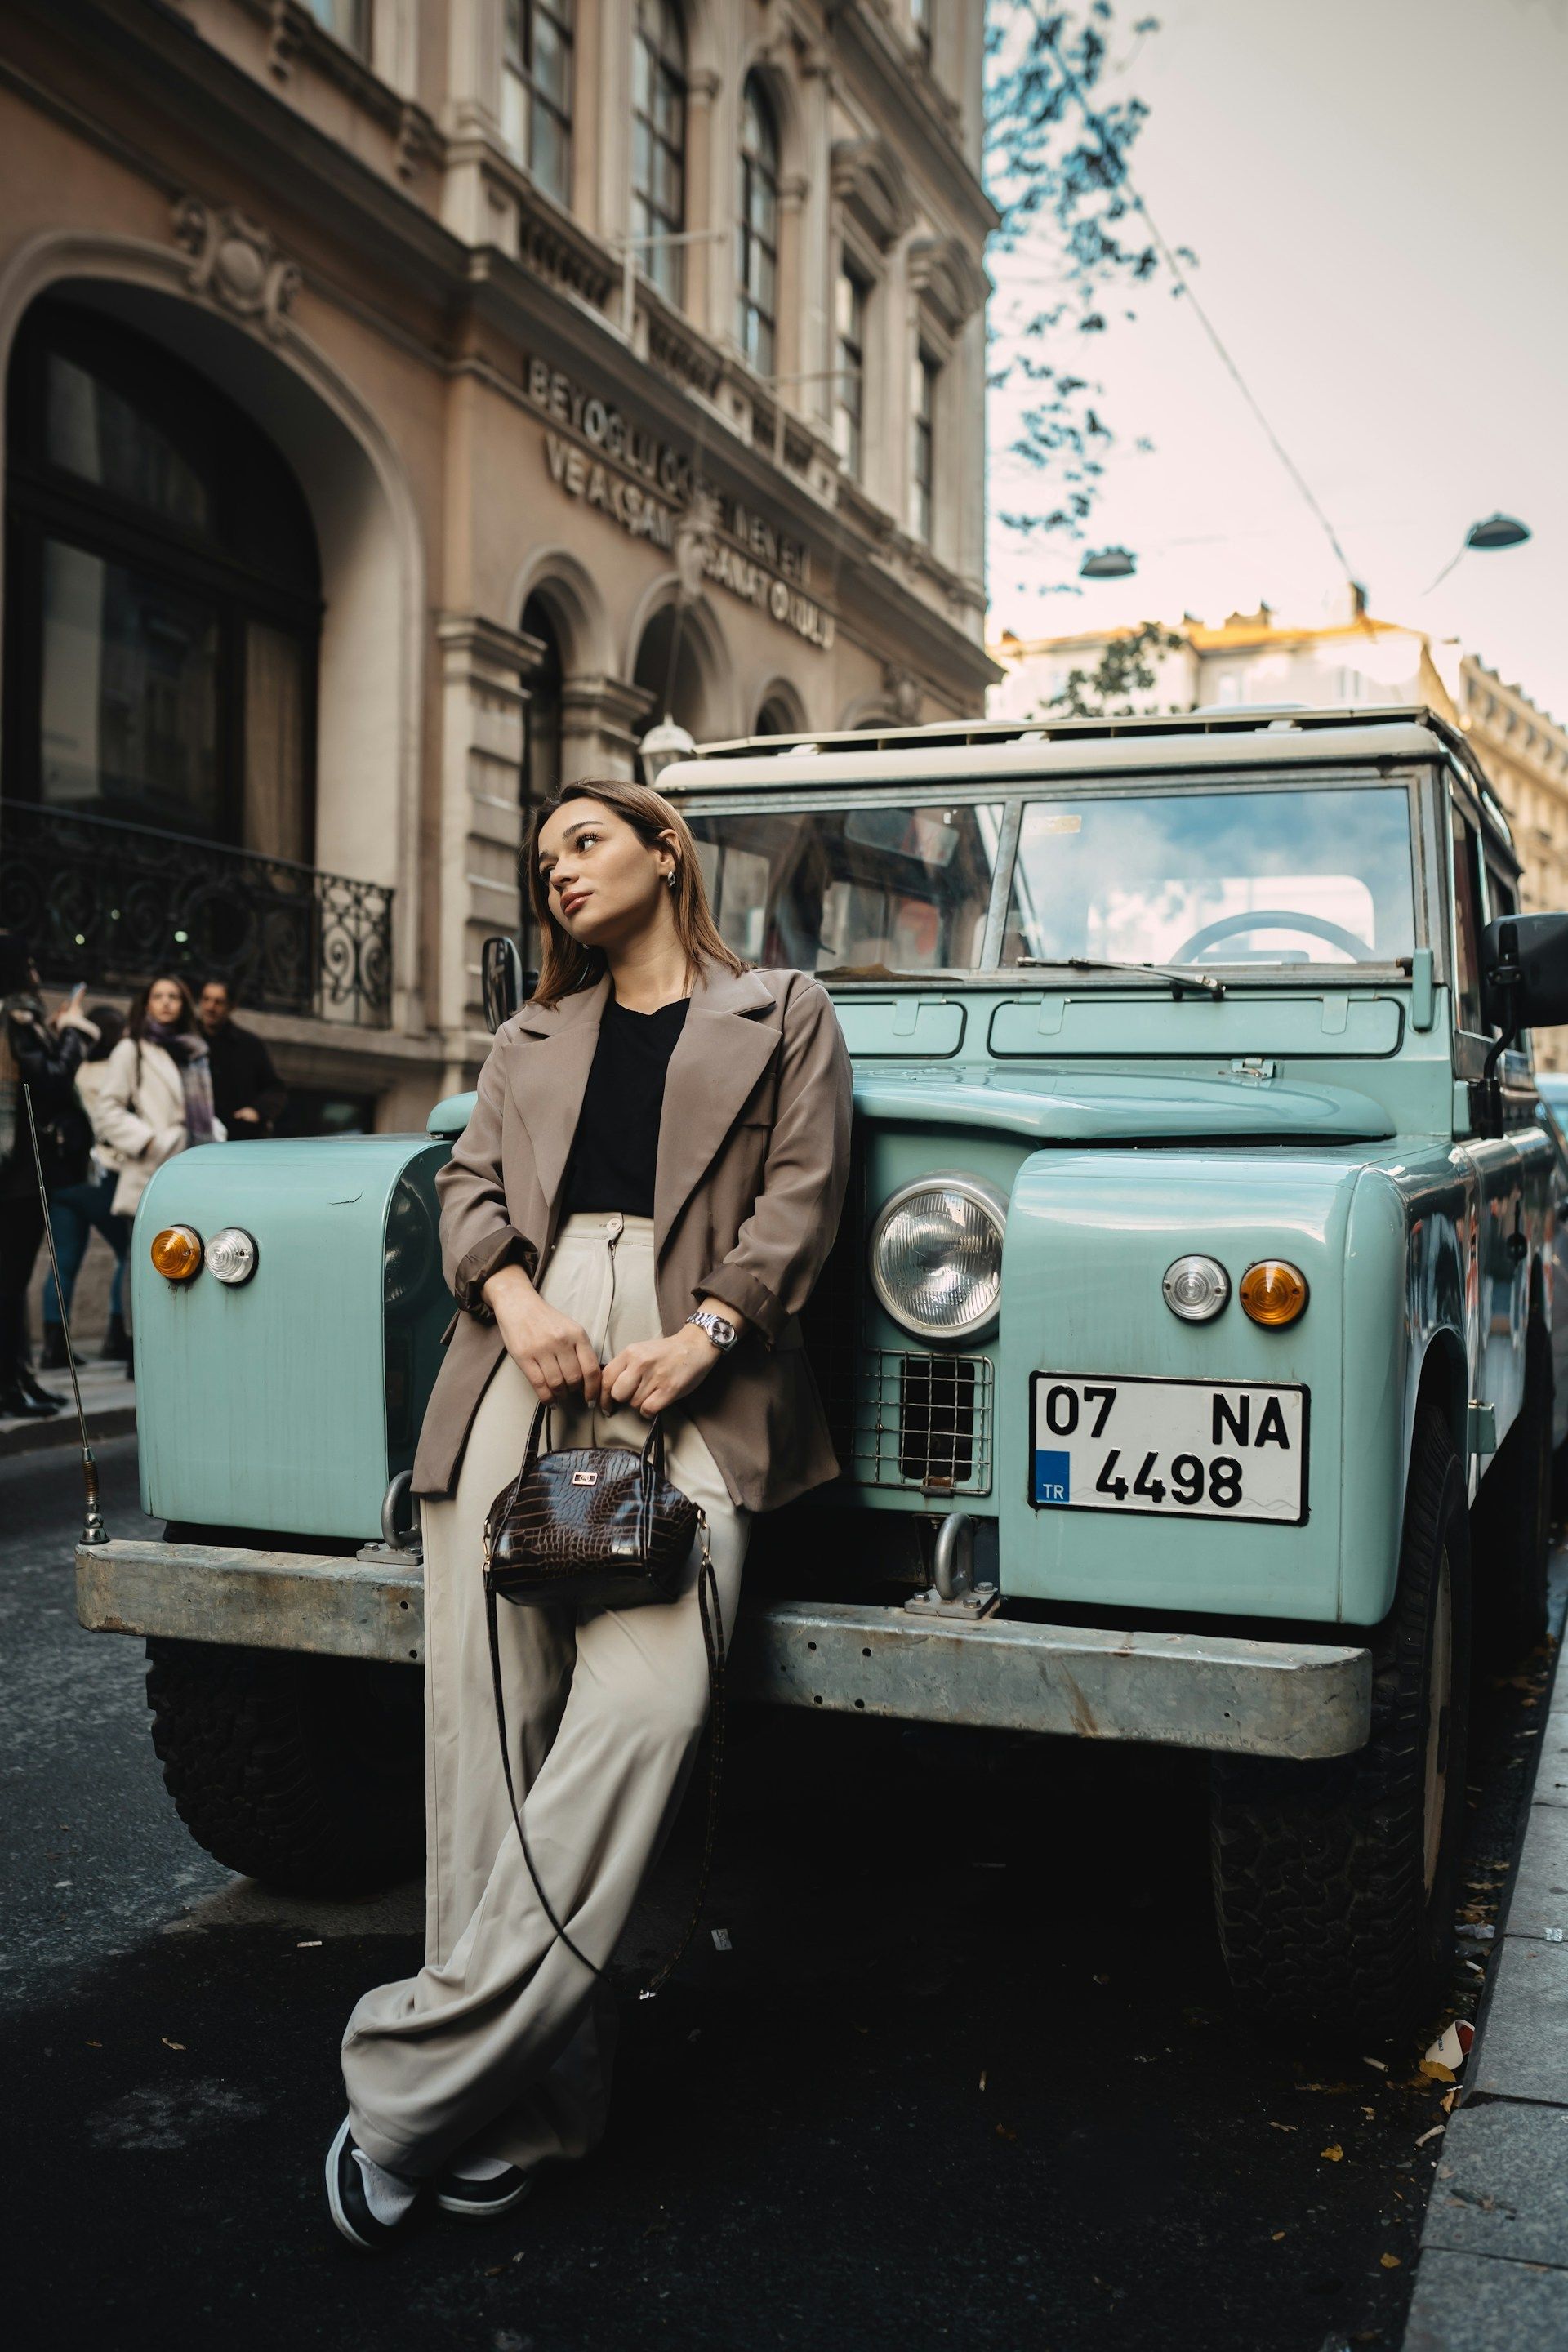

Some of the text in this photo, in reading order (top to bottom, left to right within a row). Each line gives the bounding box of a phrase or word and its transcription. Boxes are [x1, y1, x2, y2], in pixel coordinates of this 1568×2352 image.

[546, 430, 586, 497] VE
[1046, 1384, 1290, 1450] 07 NA
[1043, 1483, 1065, 1499] TR
[1095, 1449, 1243, 1508] 4498
